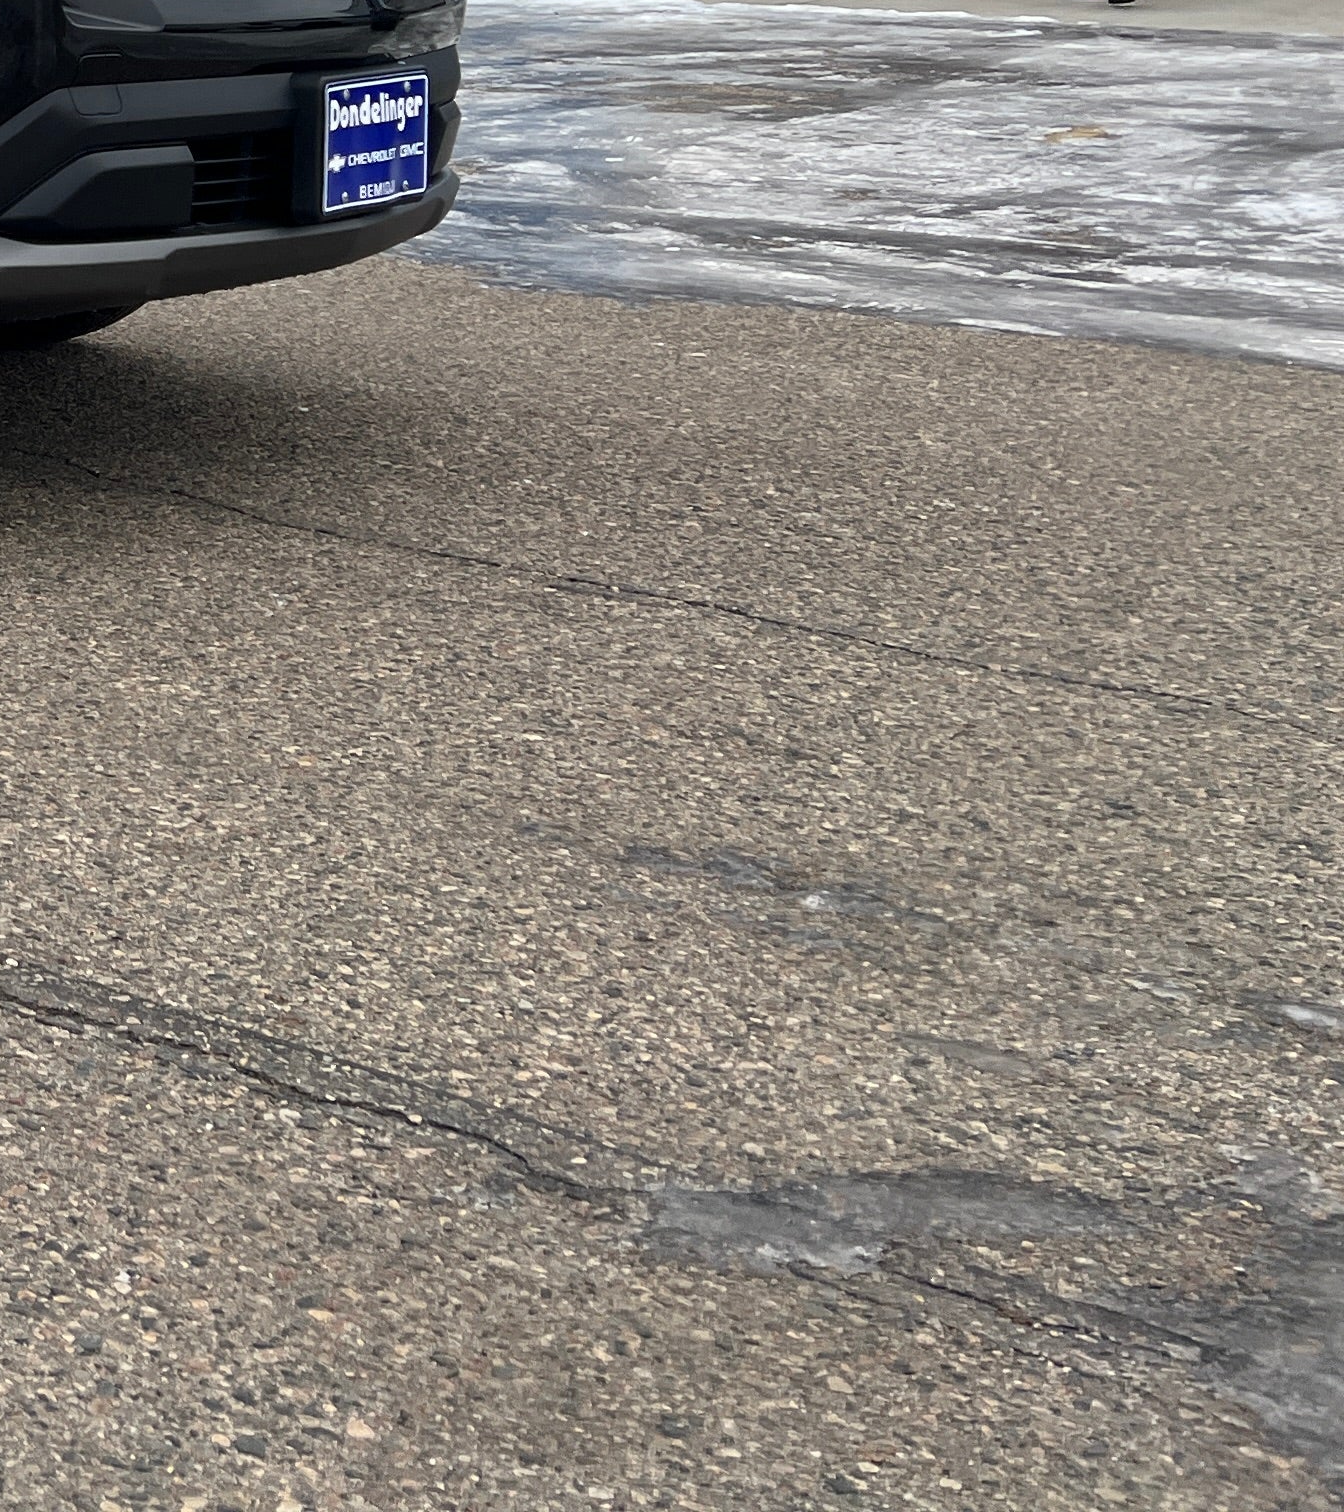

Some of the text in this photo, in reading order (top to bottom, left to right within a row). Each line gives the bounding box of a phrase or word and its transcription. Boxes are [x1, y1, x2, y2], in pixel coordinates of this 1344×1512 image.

[330, 93, 423, 131] Dondelinger
[348, 142, 424, 166] CHEVROLET GMC
